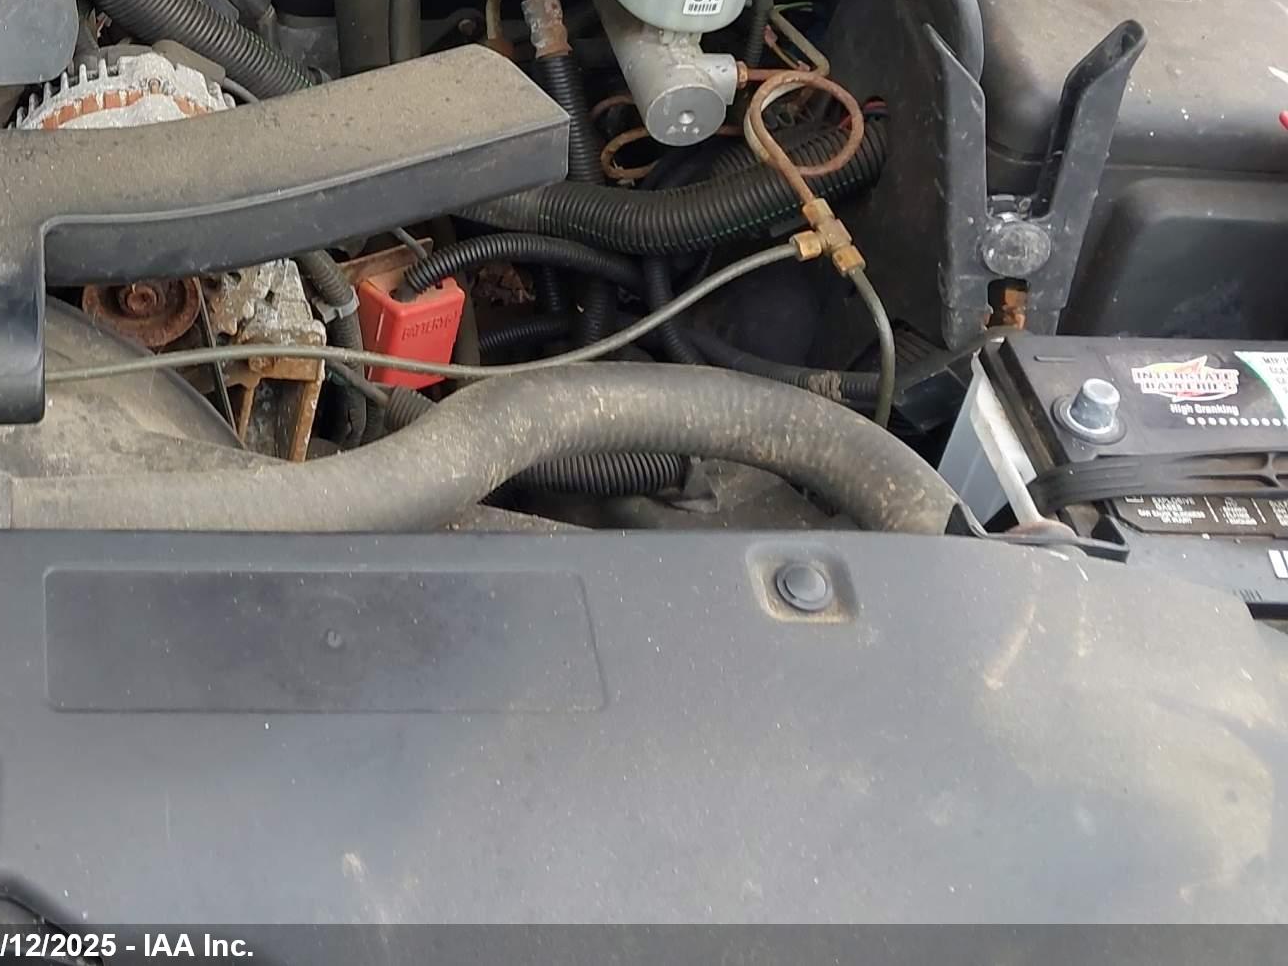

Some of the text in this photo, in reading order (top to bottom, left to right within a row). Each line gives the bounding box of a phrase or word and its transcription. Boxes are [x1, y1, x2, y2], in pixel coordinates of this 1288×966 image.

[1135, 371, 1232, 381] INTERSTATE
[1145, 382, 1235, 391] BATTERIES
[1170, 403, 1194, 415] High
